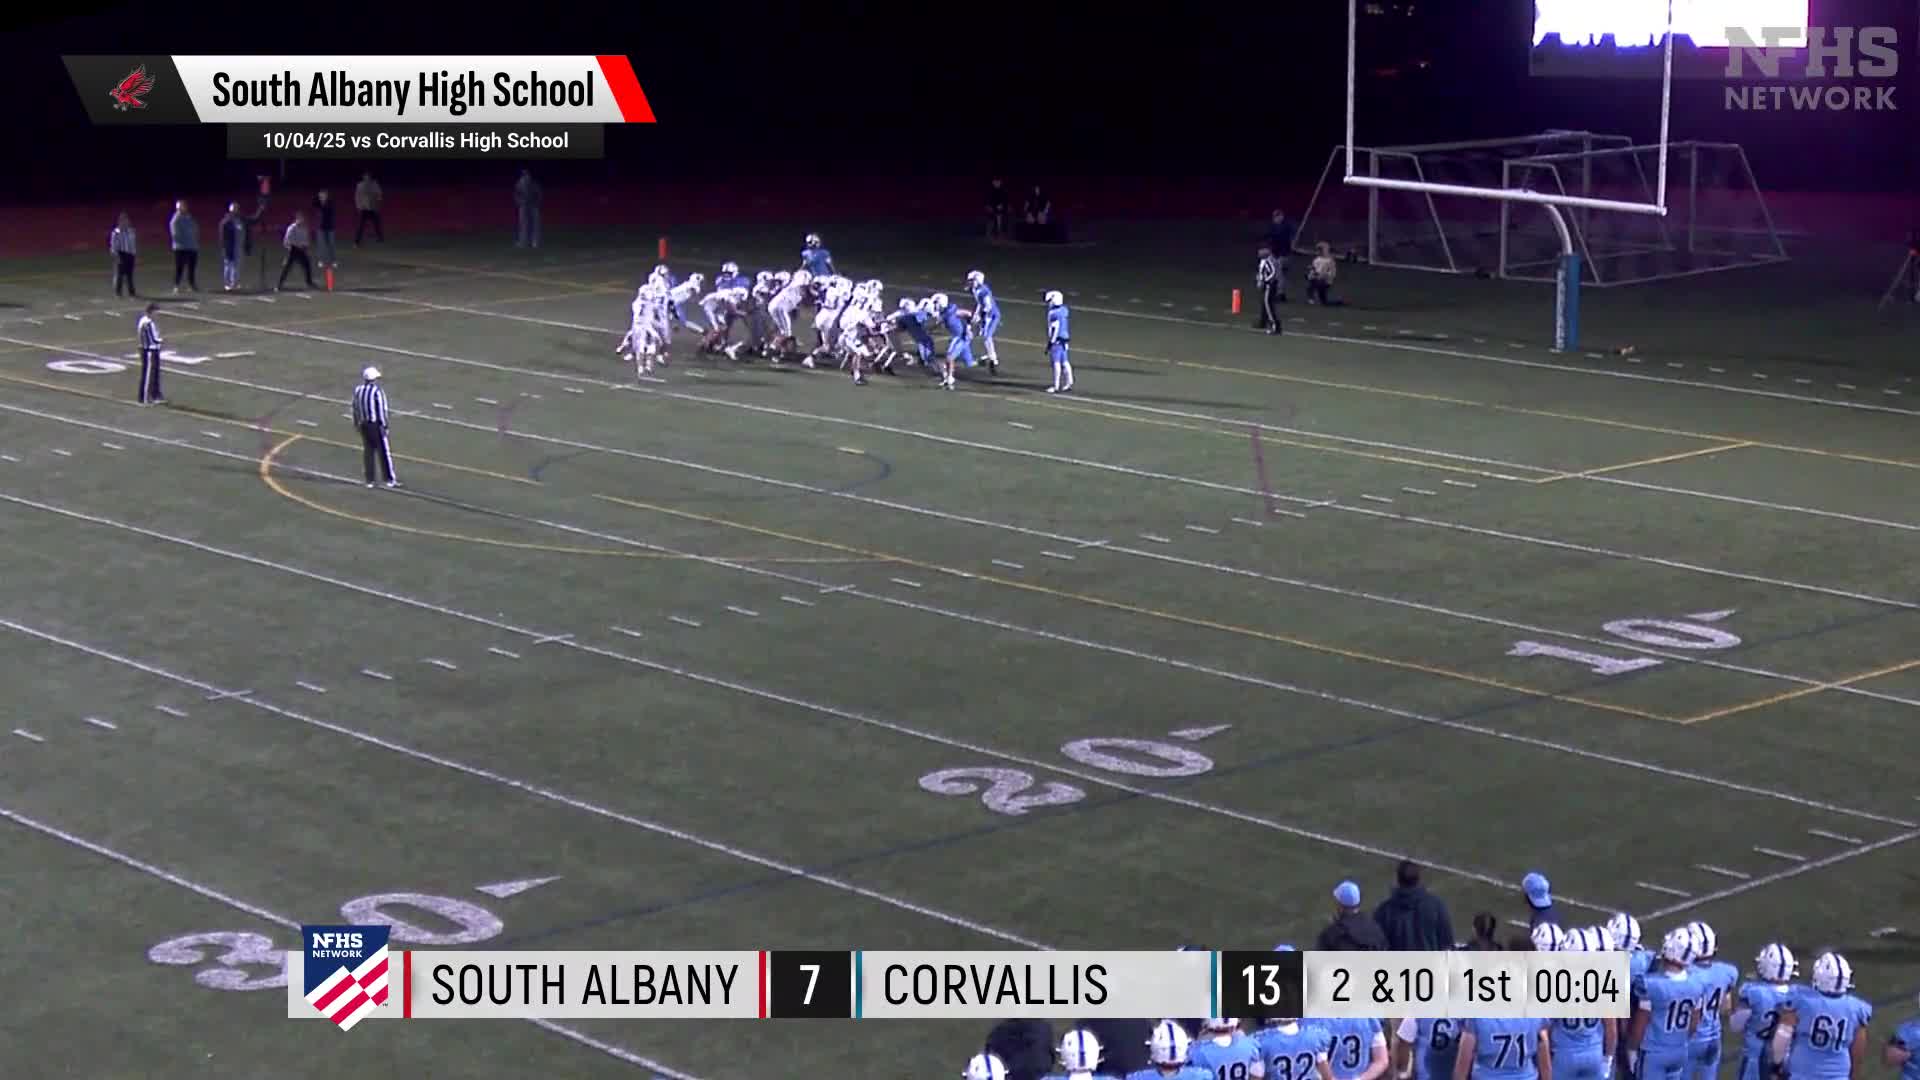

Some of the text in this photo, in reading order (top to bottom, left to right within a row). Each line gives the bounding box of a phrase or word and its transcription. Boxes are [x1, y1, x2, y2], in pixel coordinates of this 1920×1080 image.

[1505, 619, 1741, 675] 10
[918, 738, 1214, 815] 20
[1666, 998, 1694, 1031] 16
[1810, 1014, 1846, 1052] 61
[1492, 1033, 1524, 1069] 71
